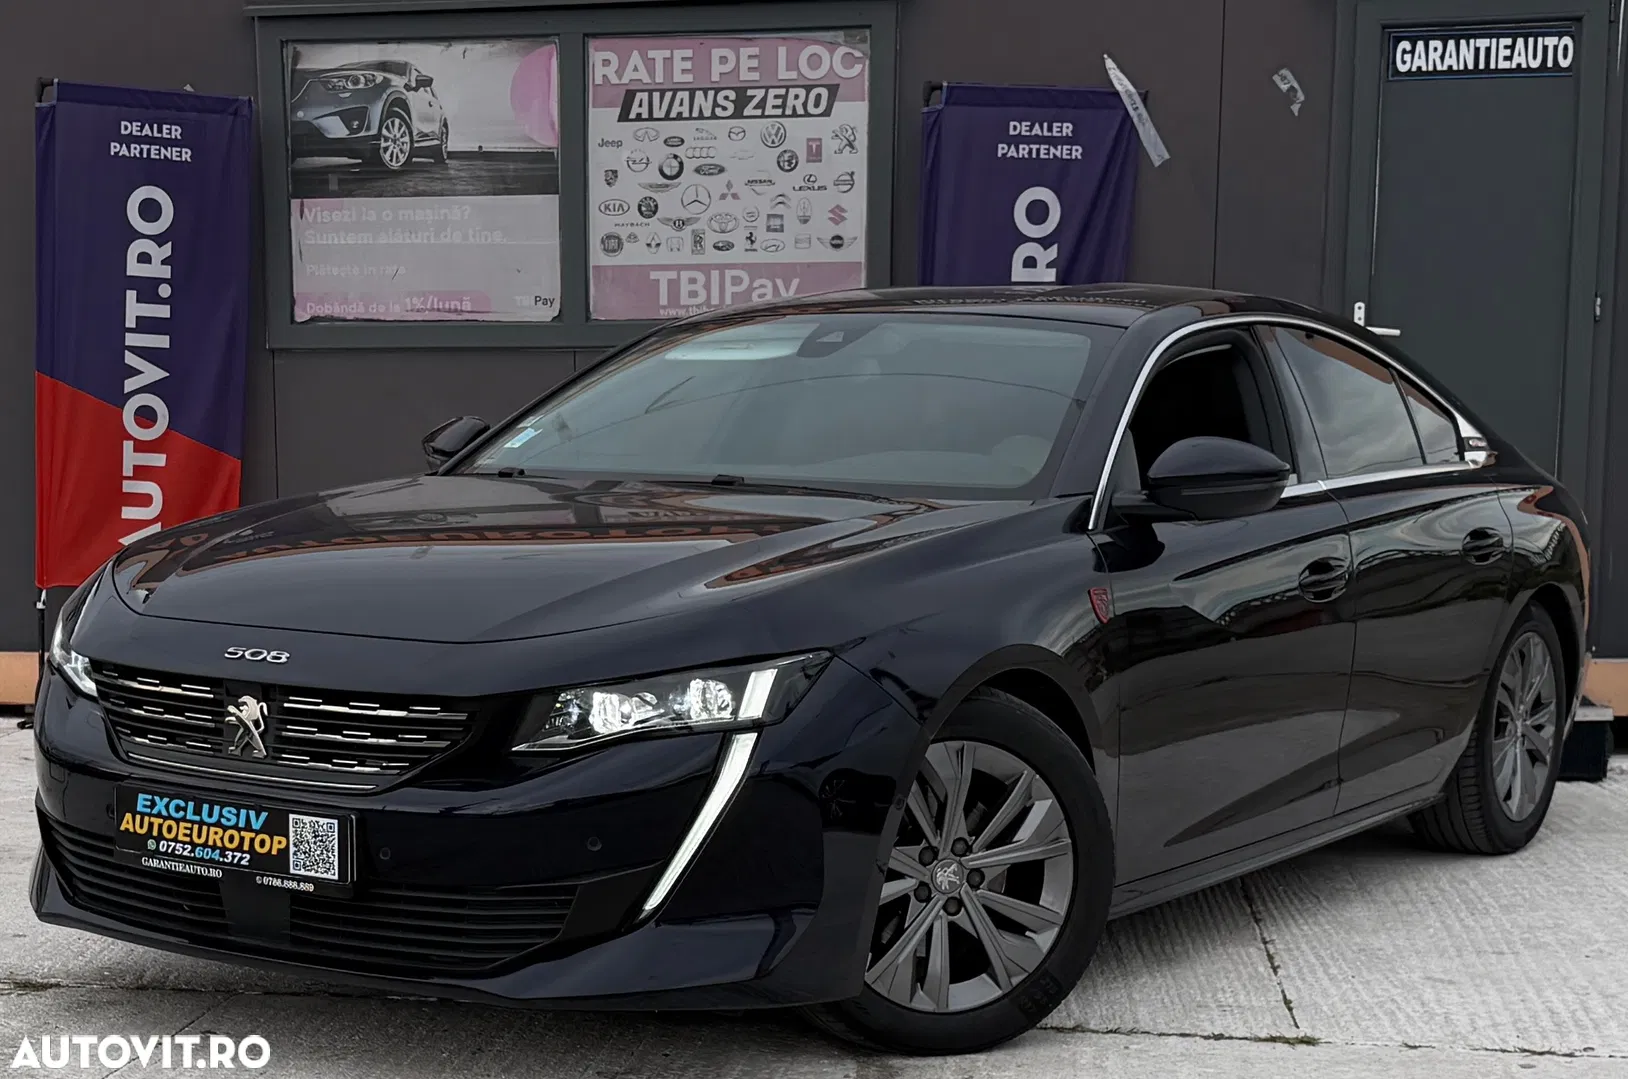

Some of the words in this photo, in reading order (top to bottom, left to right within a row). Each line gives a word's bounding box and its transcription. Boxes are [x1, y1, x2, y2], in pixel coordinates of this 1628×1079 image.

[1395, 36, 1574, 72] GARANTIEAUTO
[593, 49, 694, 85] RATE
[710, 46, 760, 81] PE
[777, 45, 863, 80] LOC
[628, 89, 737, 119] AVANS
[743, 87, 828, 117] ZERO
[120, 121, 182, 139] DEALER
[1009, 121, 1074, 137] DEALER
[110, 142, 192, 162] PARTENER
[598, 138, 623, 148] Jeep
[997, 144, 1083, 159] PARTENER
[304, 207, 356, 223] Visezi
[361, 207, 376, 221] la
[382, 210, 393, 221] o
[604, 203, 626, 212] KIA
[304, 230, 373, 244] Suntem
[440, 228, 462, 243] de
[1011, 186, 1061, 282] RO
[368, 301, 386, 313] de
[390, 301, 401, 313] la
[534, 295, 555, 307] Pay
[224, 646, 290, 663] 508
[136, 793, 268, 830] EXCLUSIV
[120, 812, 287, 855] AUTOEUROTOP
[159, 840, 251, 865] 0752.604.372
[141, 856, 223, 878] GARANTIEAUTO.RO
